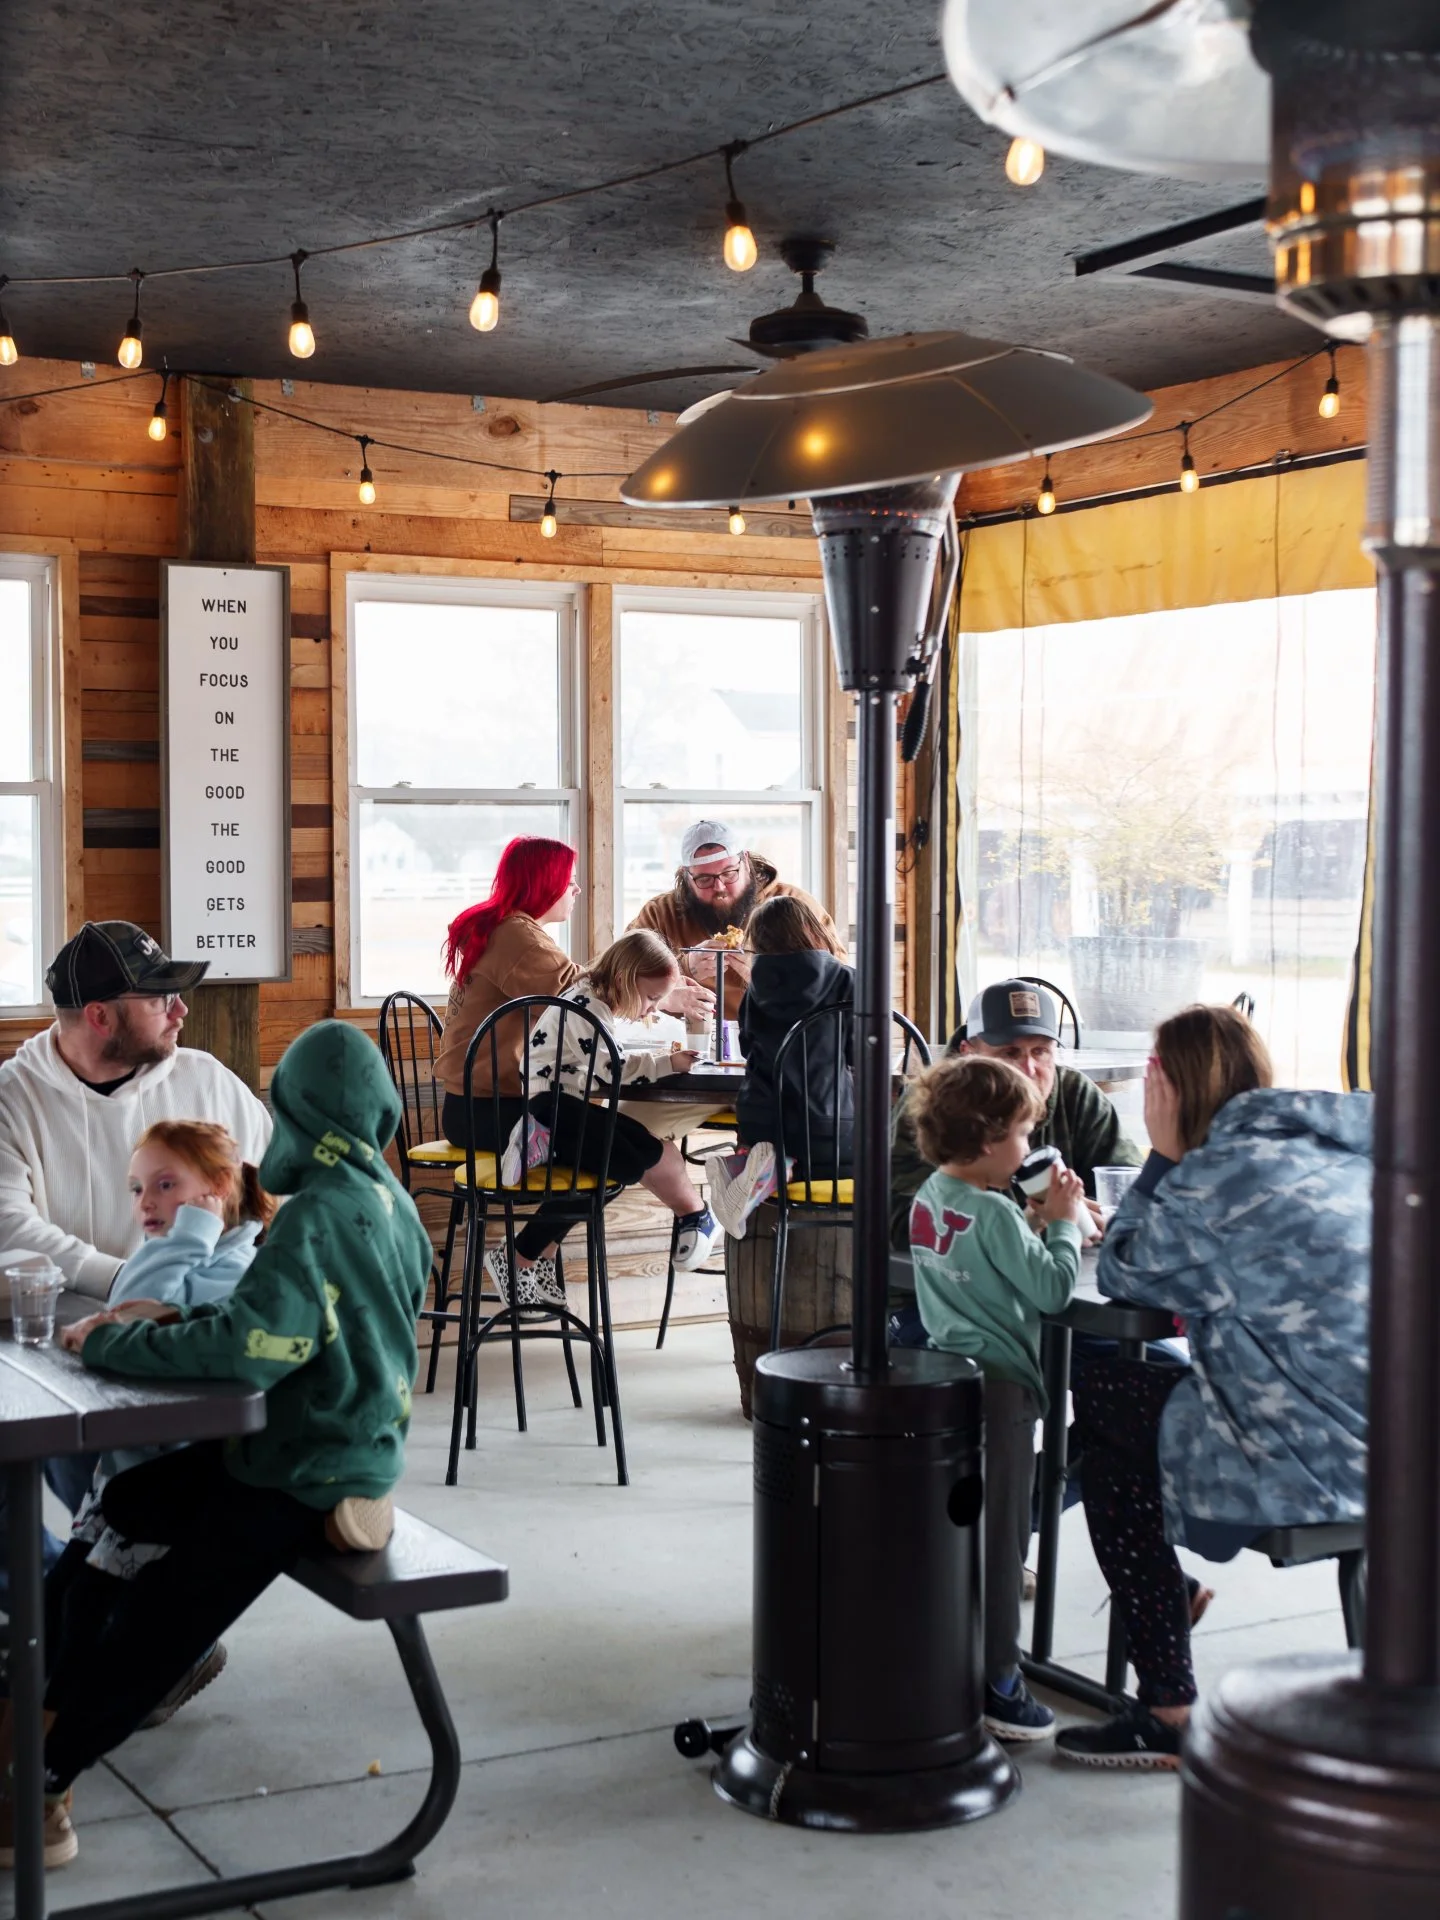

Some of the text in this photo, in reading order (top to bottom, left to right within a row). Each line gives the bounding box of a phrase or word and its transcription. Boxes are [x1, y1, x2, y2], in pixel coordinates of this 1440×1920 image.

[201, 598, 247, 614] WHEN
[209, 635, 239, 651] YOU
[199, 672, 249, 688] FOCUS
[214, 710, 234, 725] ON
[209, 747, 240, 763] THE
[205, 785, 245, 800] GOOD
[210, 822, 240, 837] THE
[205, 859, 246, 874] GOOD
[206, 897, 245, 912] GETS
[196, 934, 256, 949] BETTER
